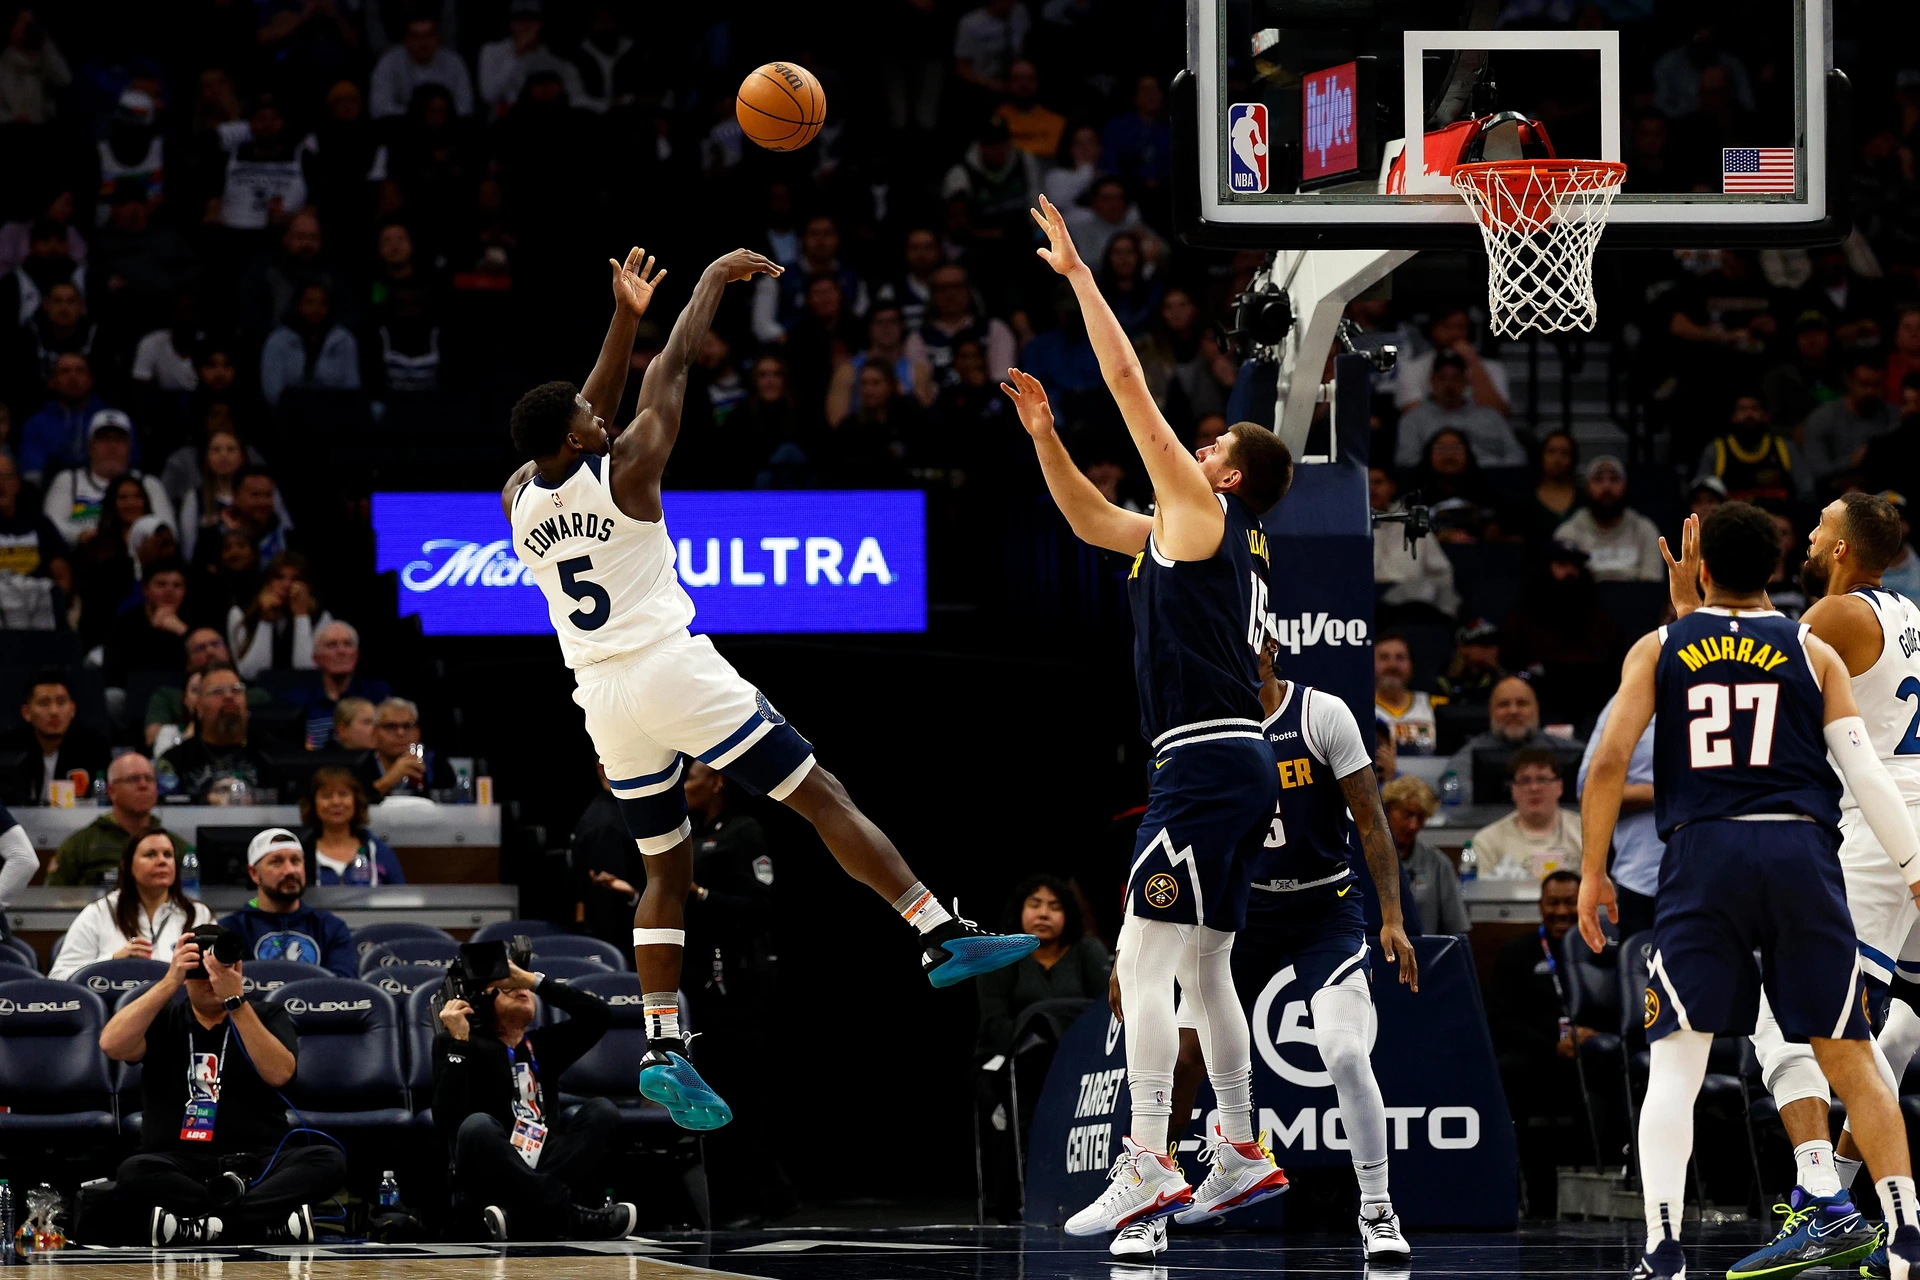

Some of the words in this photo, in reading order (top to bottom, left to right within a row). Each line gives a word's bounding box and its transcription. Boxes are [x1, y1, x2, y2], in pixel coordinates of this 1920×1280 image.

[1234, 172, 1254, 187] NBA
[523, 512, 615, 558] EDWARDS
[678, 536, 893, 587] ULTRA
[556, 554, 611, 631] 5
[1247, 569, 1268, 656] 15
[1677, 636, 1789, 672] MURRAY
[1269, 730, 1298, 742] ibotta
[1687, 682, 1779, 769] 27
[1893, 675, 1920, 756] 2
[16, 999, 81, 1013] LEXUS
[308, 999, 373, 1012] LEXUS
[1074, 1067, 1126, 1119] TARGET
[1066, 1122, 1112, 1174] CENTER
